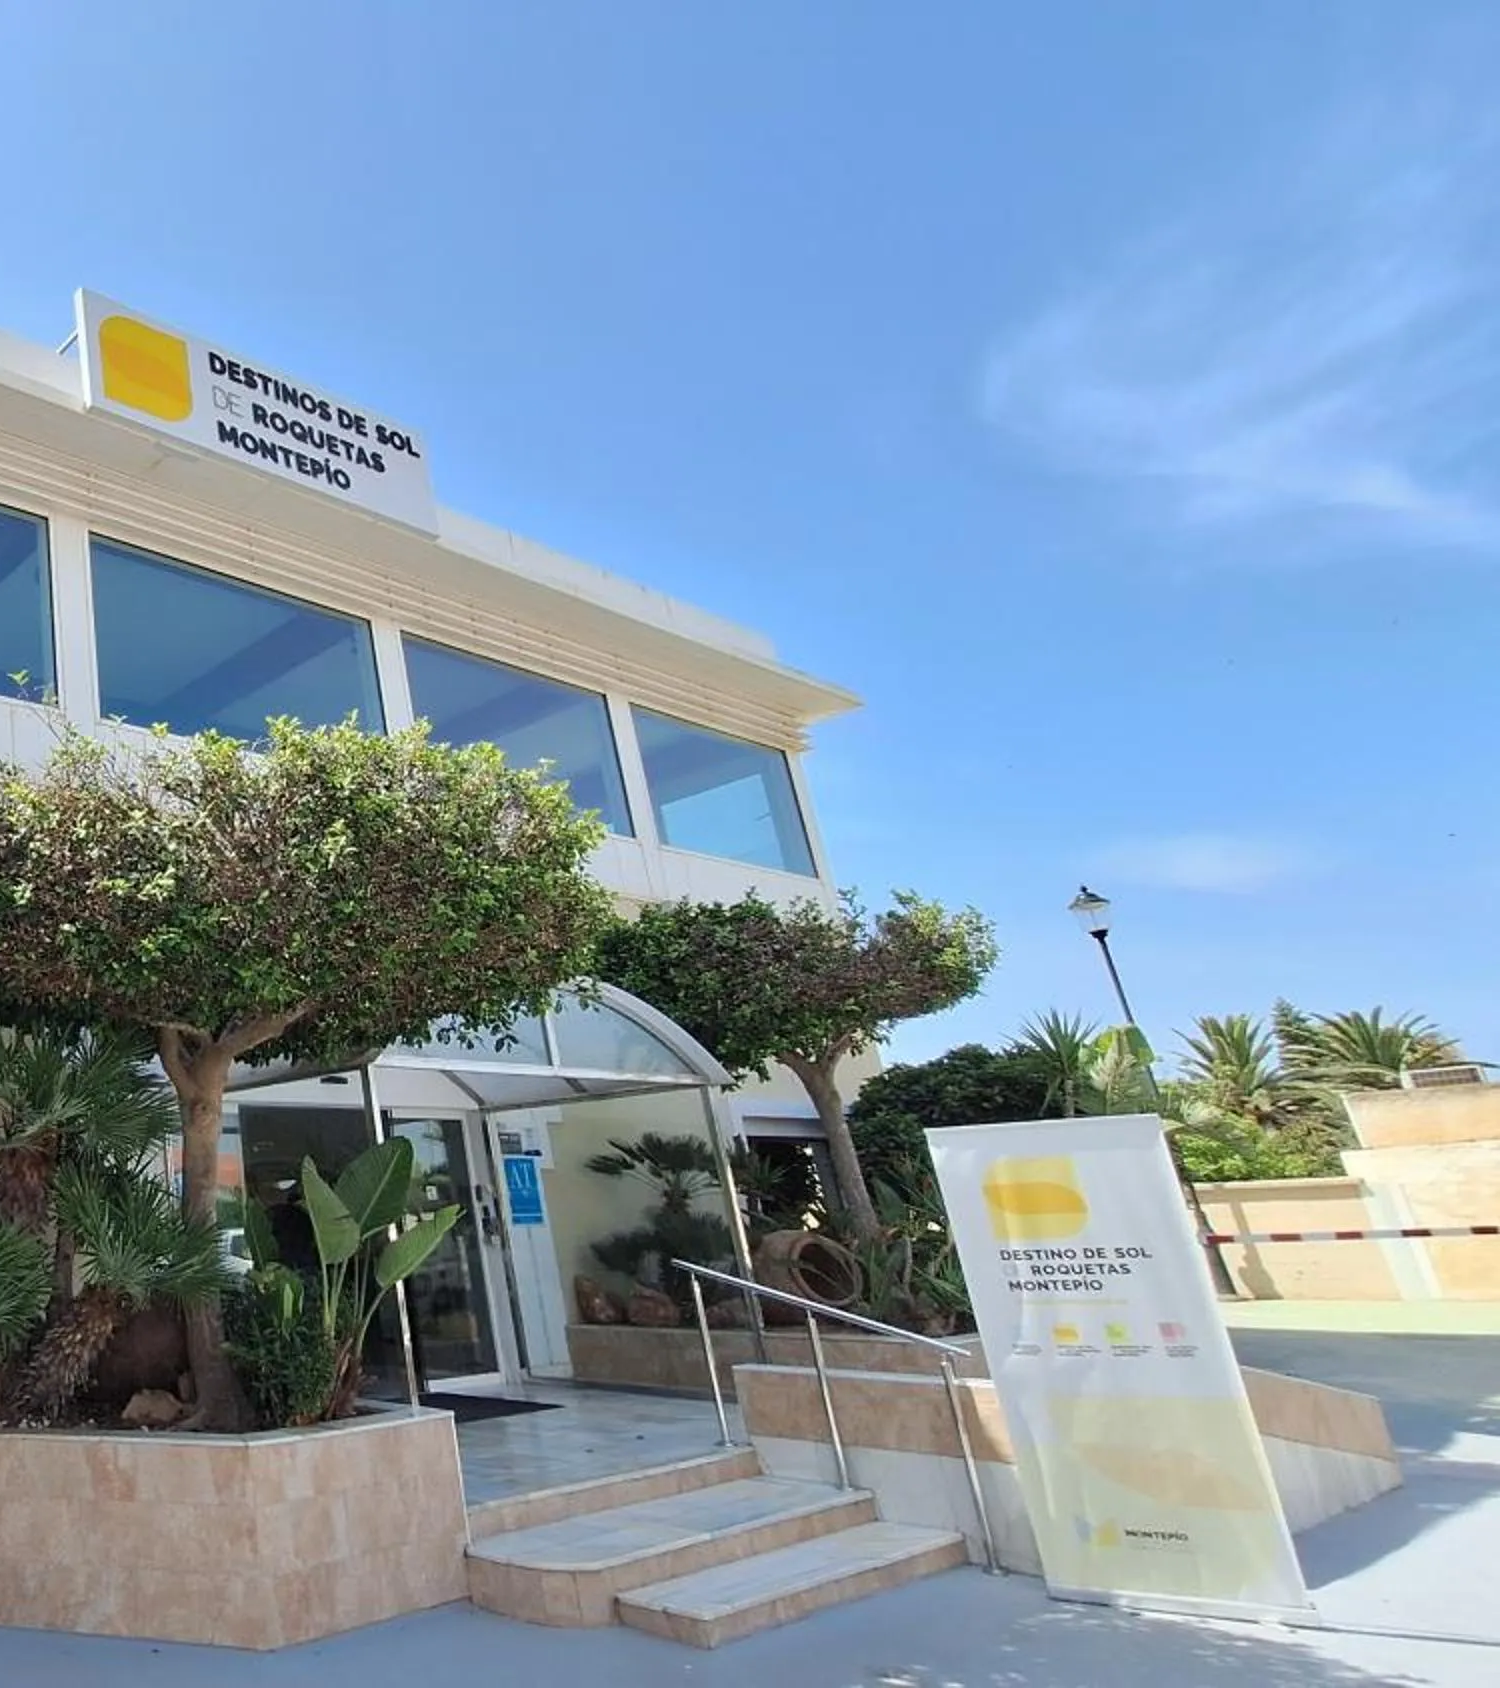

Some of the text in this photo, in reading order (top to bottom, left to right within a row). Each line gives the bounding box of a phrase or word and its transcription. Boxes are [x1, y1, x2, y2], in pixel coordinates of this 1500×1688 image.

[208, 351, 420, 459] DESTINOS DE SOL
[212, 385, 385, 473] DE ROQUETAS
[217, 420, 351, 490] MONTEPÍO
[1000, 1247, 1154, 1261] DESTINO DE SOL
[1030, 1263, 1132, 1276] ROQUETAS
